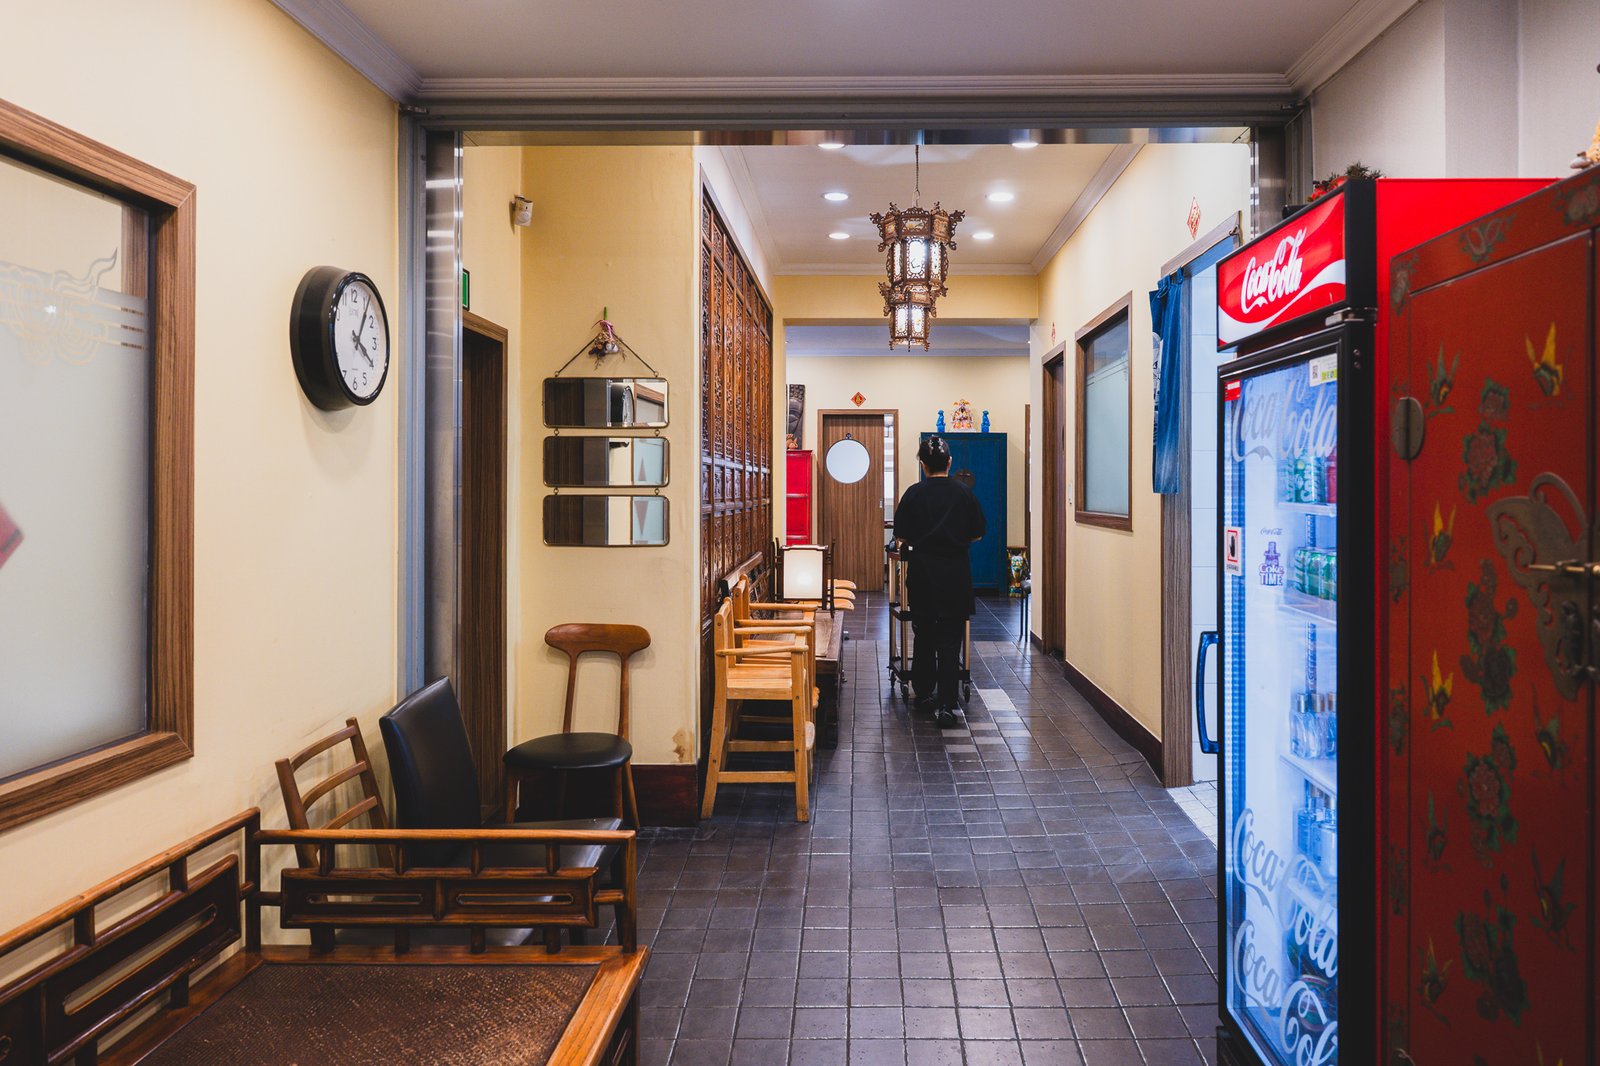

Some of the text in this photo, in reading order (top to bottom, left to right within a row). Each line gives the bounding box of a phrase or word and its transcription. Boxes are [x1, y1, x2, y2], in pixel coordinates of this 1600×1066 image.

[1241, 227, 1307, 314] Coca-Cola
[342, 292, 347, 306] 11
[351, 289, 358, 303] 12
[369, 315, 374, 329] 2
[372, 337, 377, 351] 3
[352, 377, 358, 390] 6
[362, 372, 368, 386] 5
[1259, 573, 1284, 586] TIME
